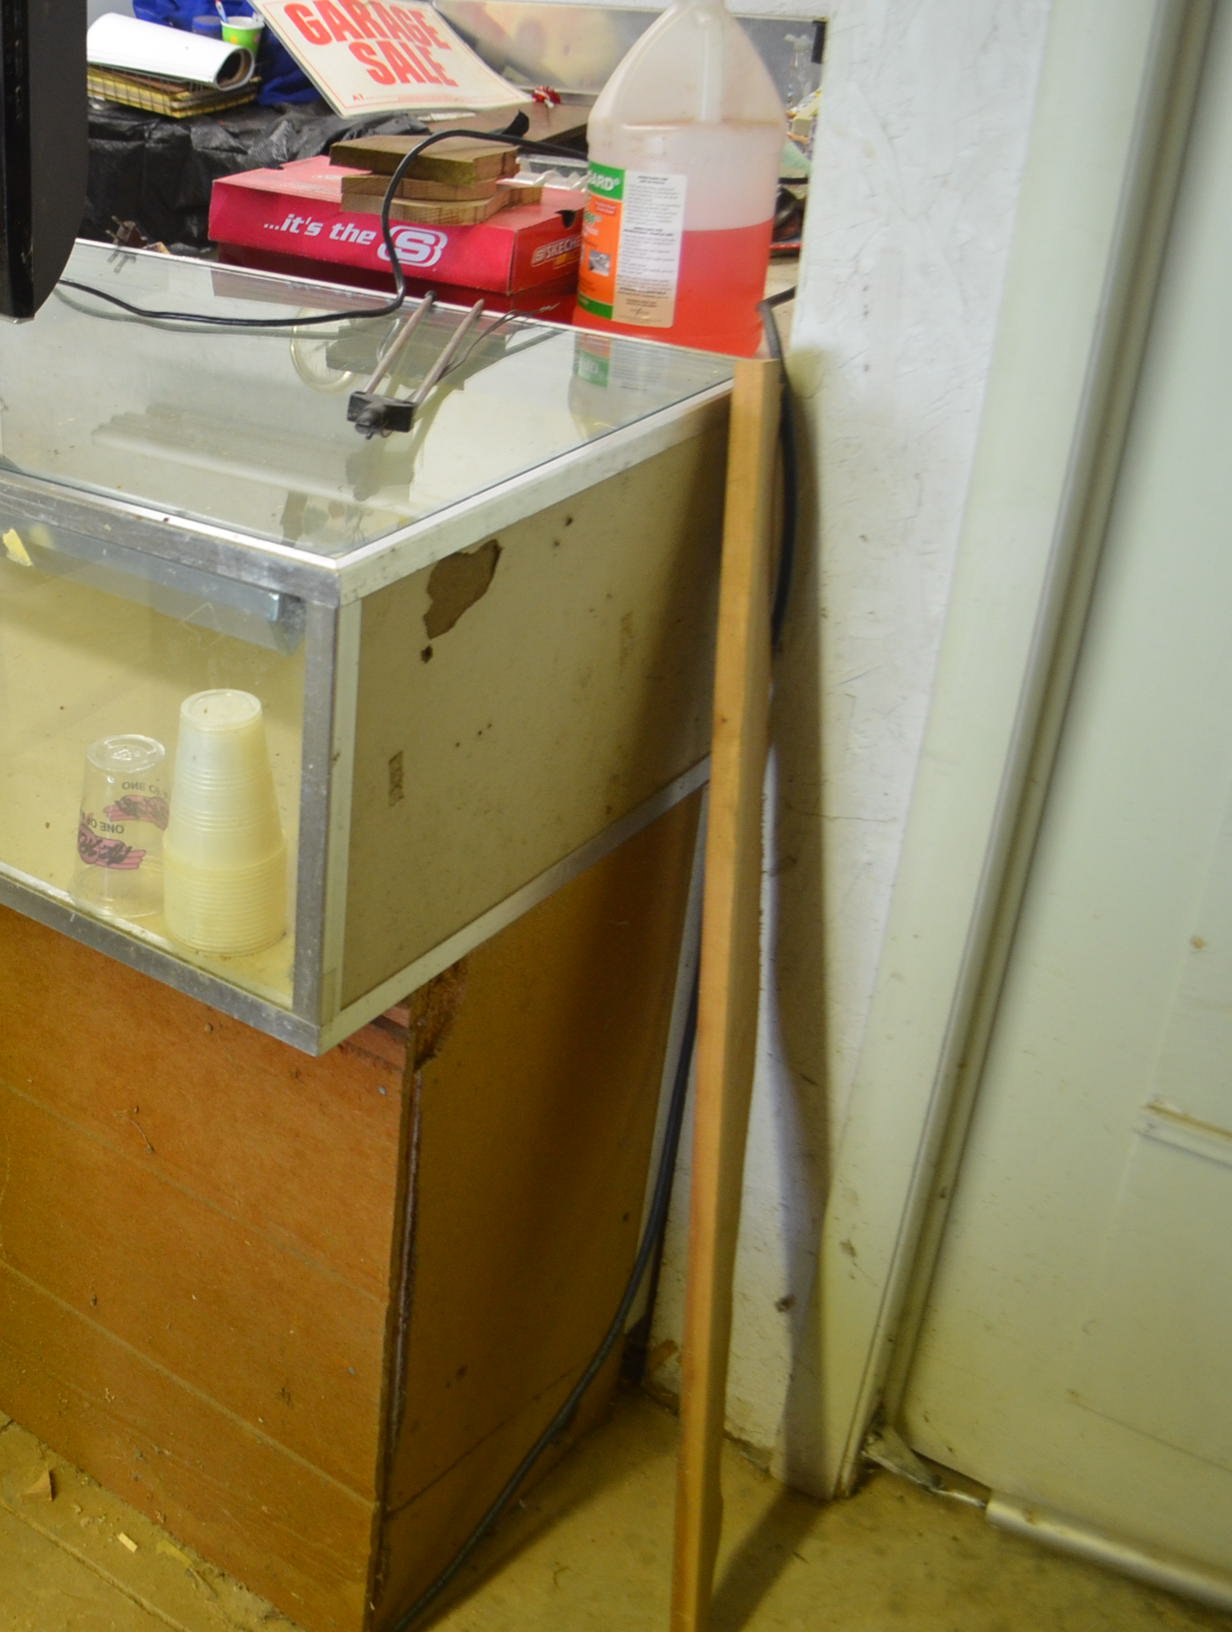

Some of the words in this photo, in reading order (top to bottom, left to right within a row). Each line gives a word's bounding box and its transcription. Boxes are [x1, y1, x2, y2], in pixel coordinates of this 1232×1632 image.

[284, 0, 452, 50] GARAGE
[348, 39, 460, 87] SALE
[329, 222, 376, 245] the
[99, 821, 125, 834] ONE
